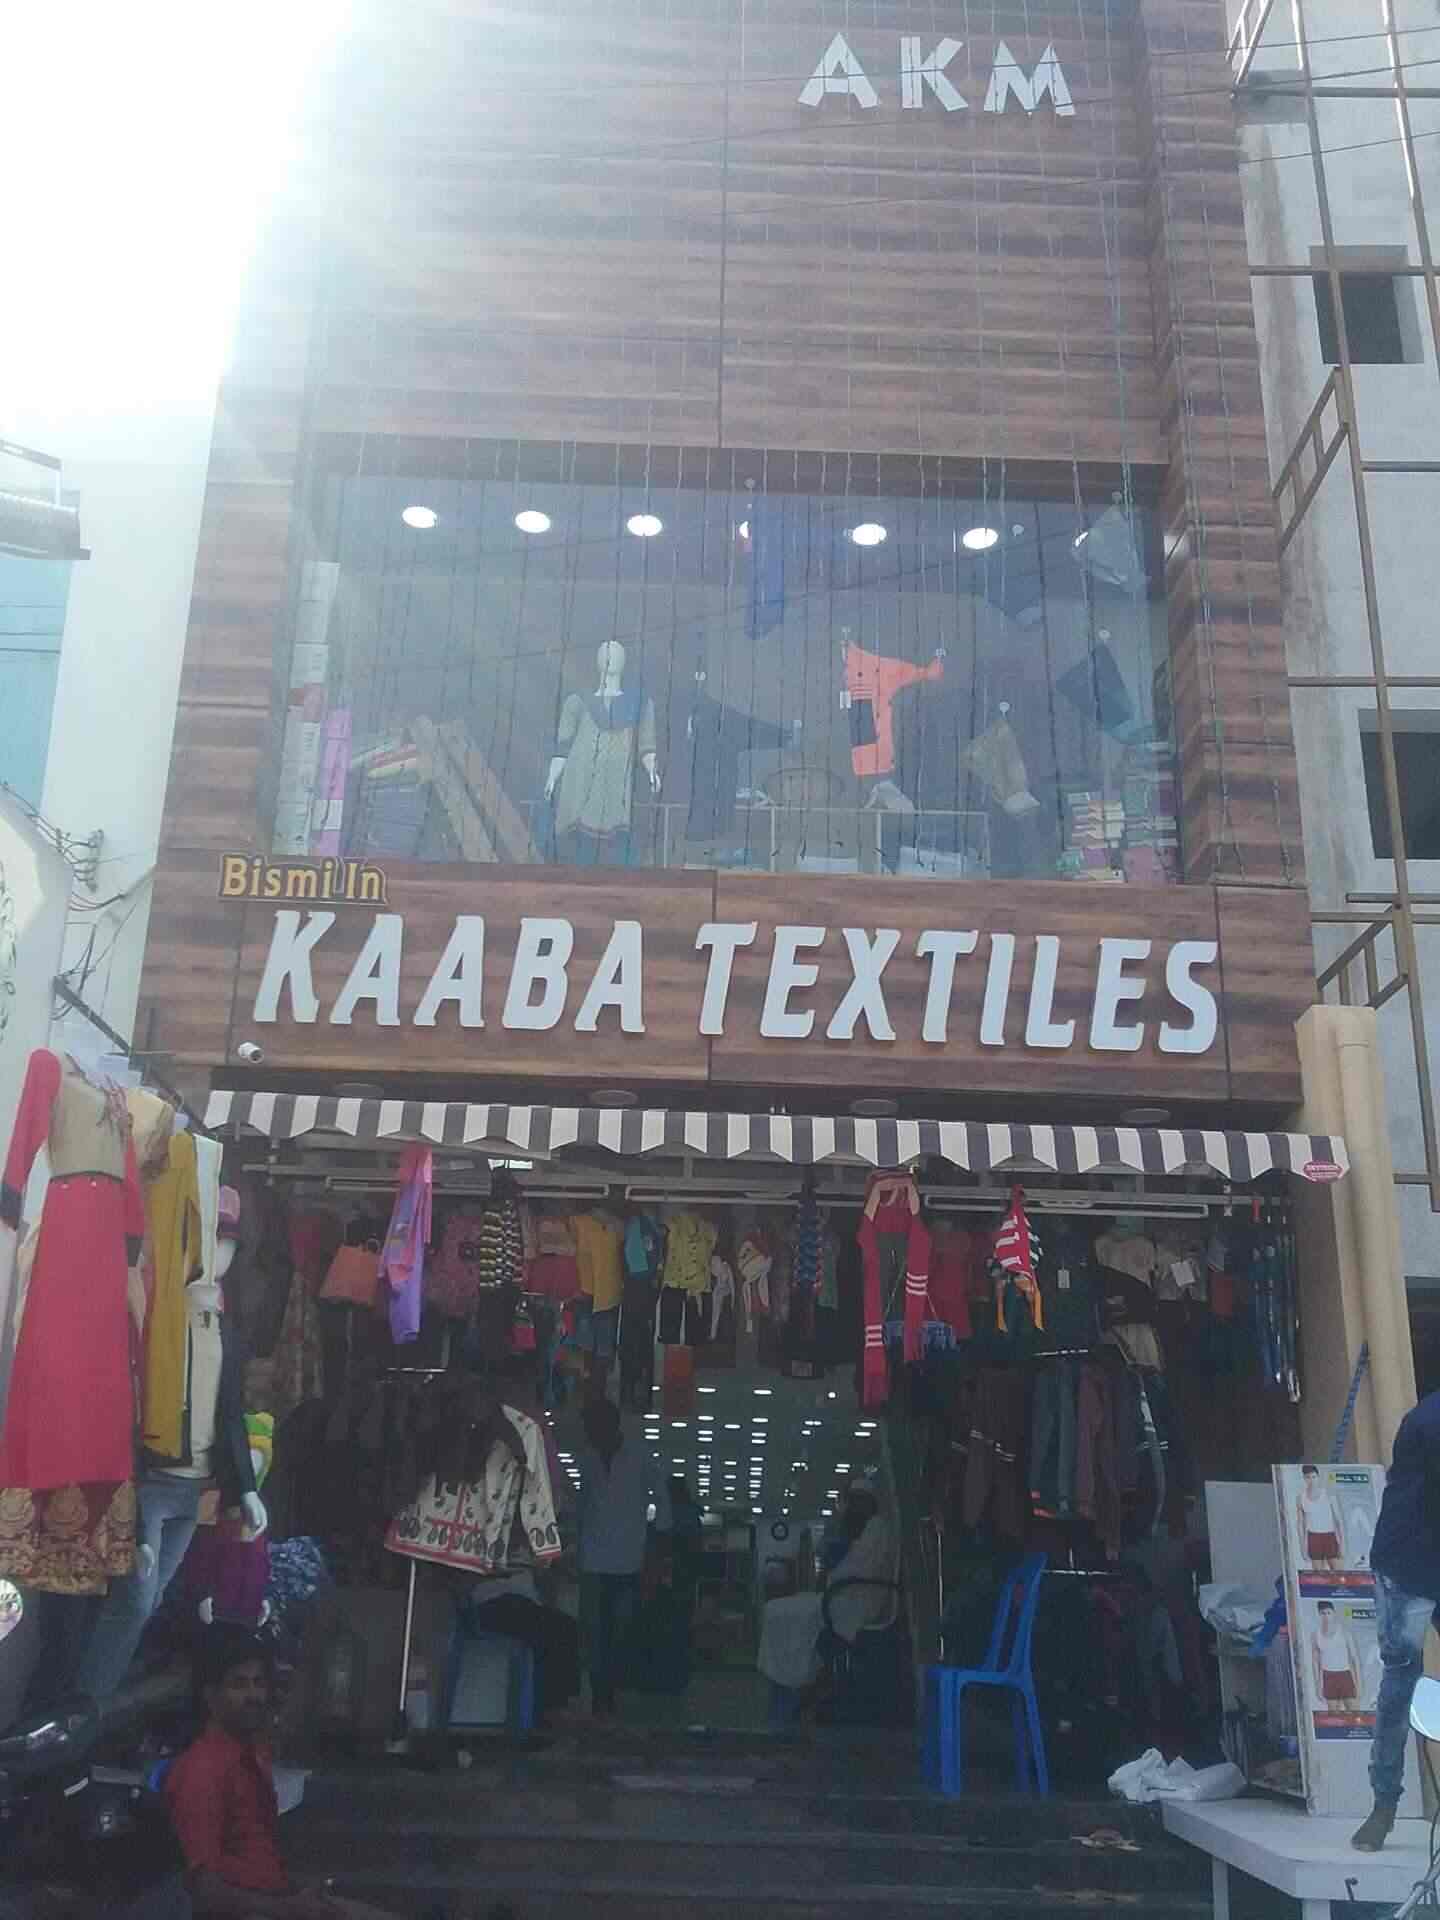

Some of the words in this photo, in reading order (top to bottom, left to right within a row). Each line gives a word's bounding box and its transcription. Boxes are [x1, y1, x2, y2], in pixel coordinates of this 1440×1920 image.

[798, 33, 1077, 117] AKM
[222, 857, 334, 897] Bismi
[253, 910, 646, 1033] KAABA
[695, 921, 1220, 1054] TEXTILES
